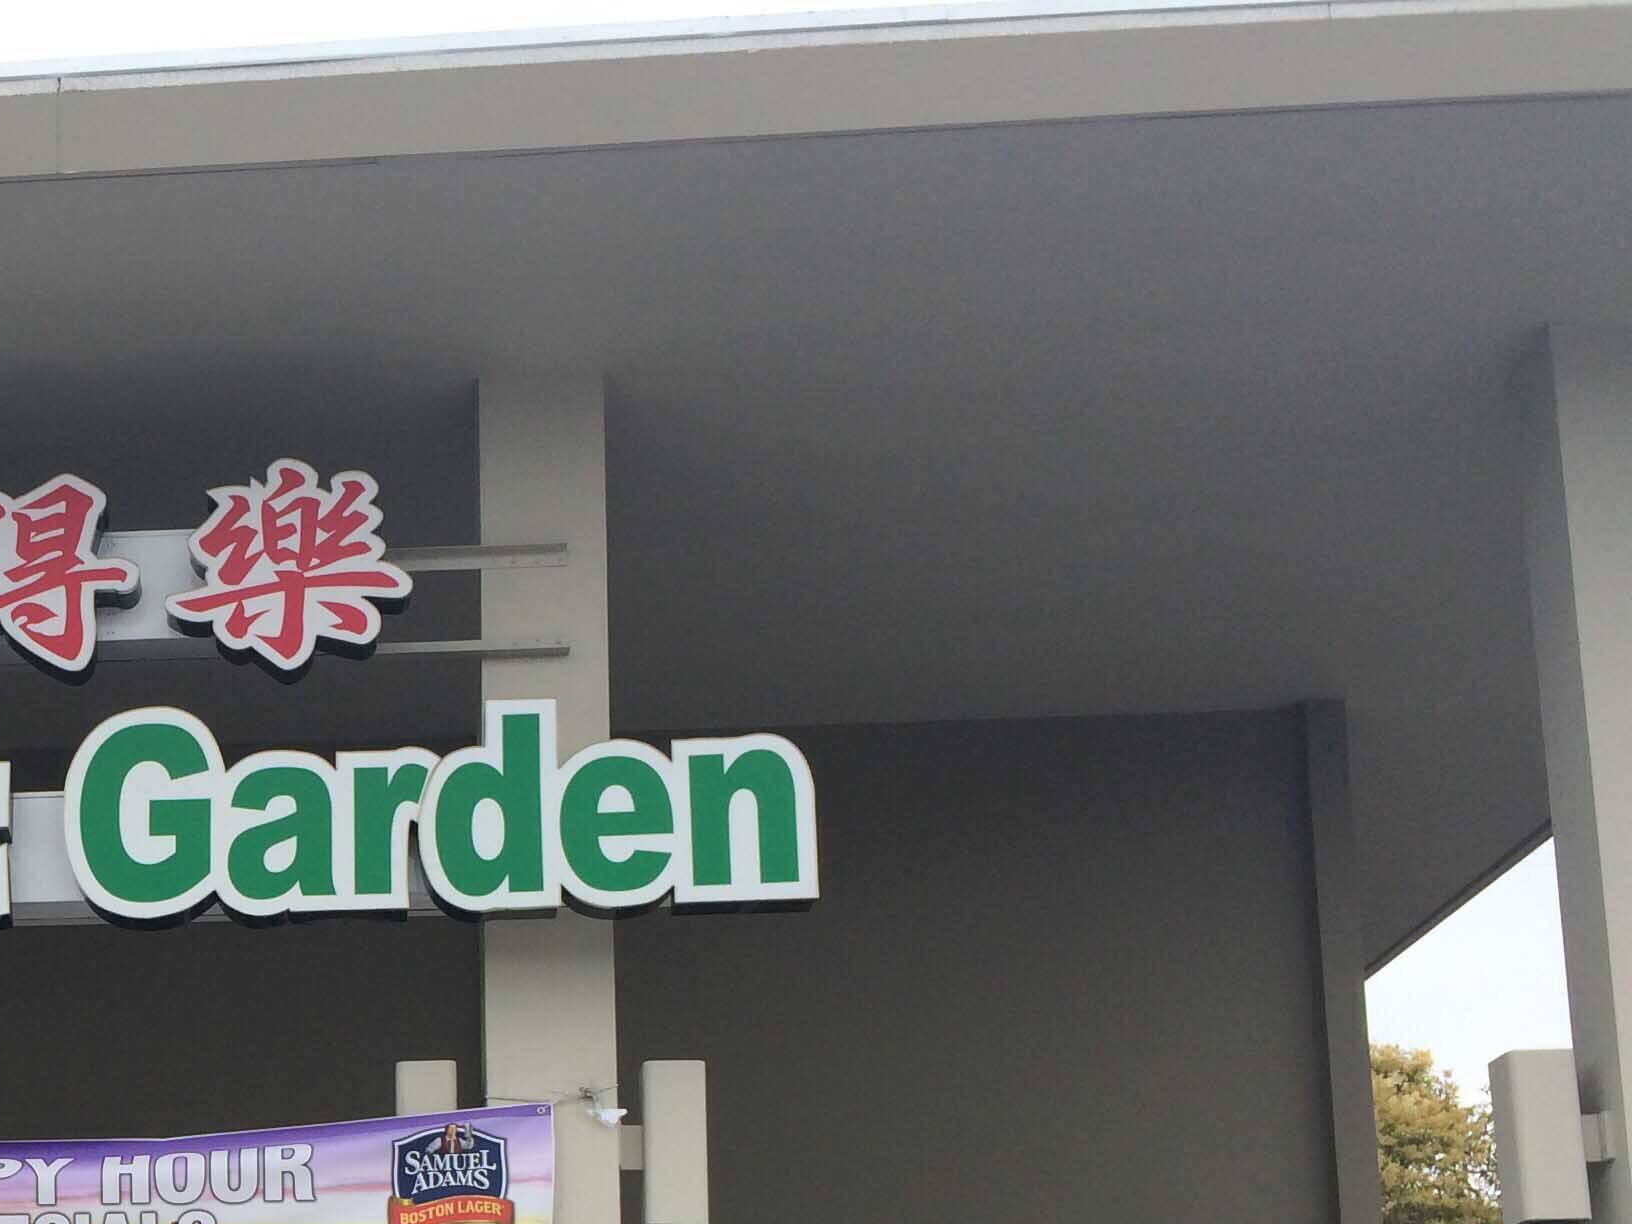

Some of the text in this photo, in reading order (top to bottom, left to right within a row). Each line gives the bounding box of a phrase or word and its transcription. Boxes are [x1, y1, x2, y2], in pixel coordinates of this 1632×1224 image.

[70, 704, 812, 912] Garden
[101, 1143, 317, 1205] HOUR
[405, 1150, 497, 1175] SAMUEL
[411, 1169, 491, 1194] ADAMS
[400, 1201, 503, 1224] BOSTON LAGER
